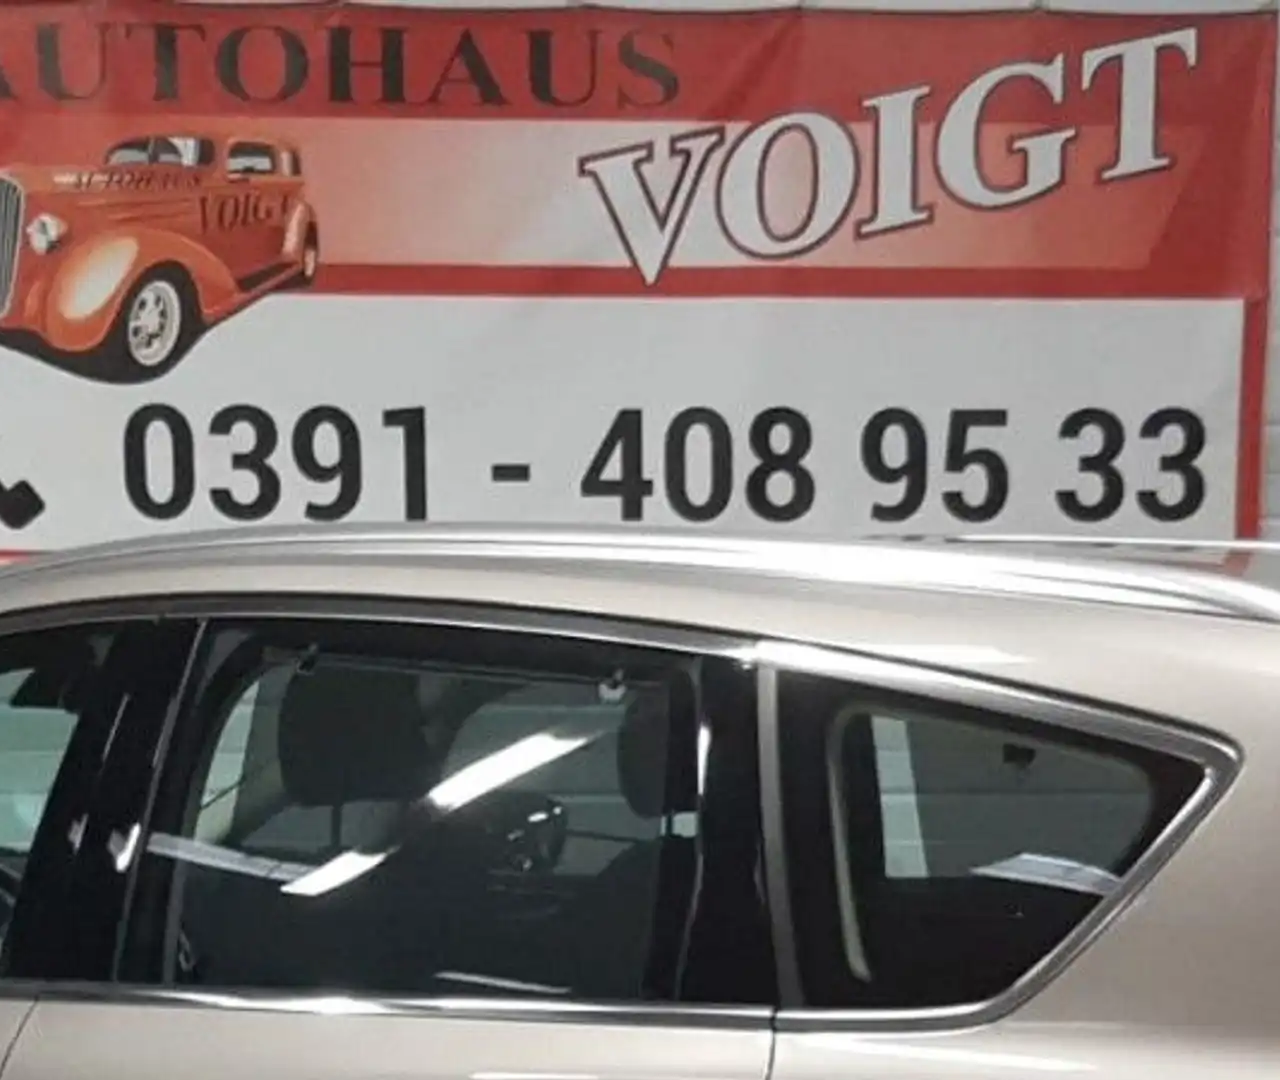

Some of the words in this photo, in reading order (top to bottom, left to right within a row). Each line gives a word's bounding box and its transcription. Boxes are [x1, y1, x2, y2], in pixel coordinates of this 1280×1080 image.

[579, 26, 1200, 286] VOIGT
[123, 403, 427, 523] 0391
[491, 464, 531, 482] -
[580, 406, 815, 523] 408
[861, 407, 1009, 524] 95
[1055, 407, 1206, 523] 33
